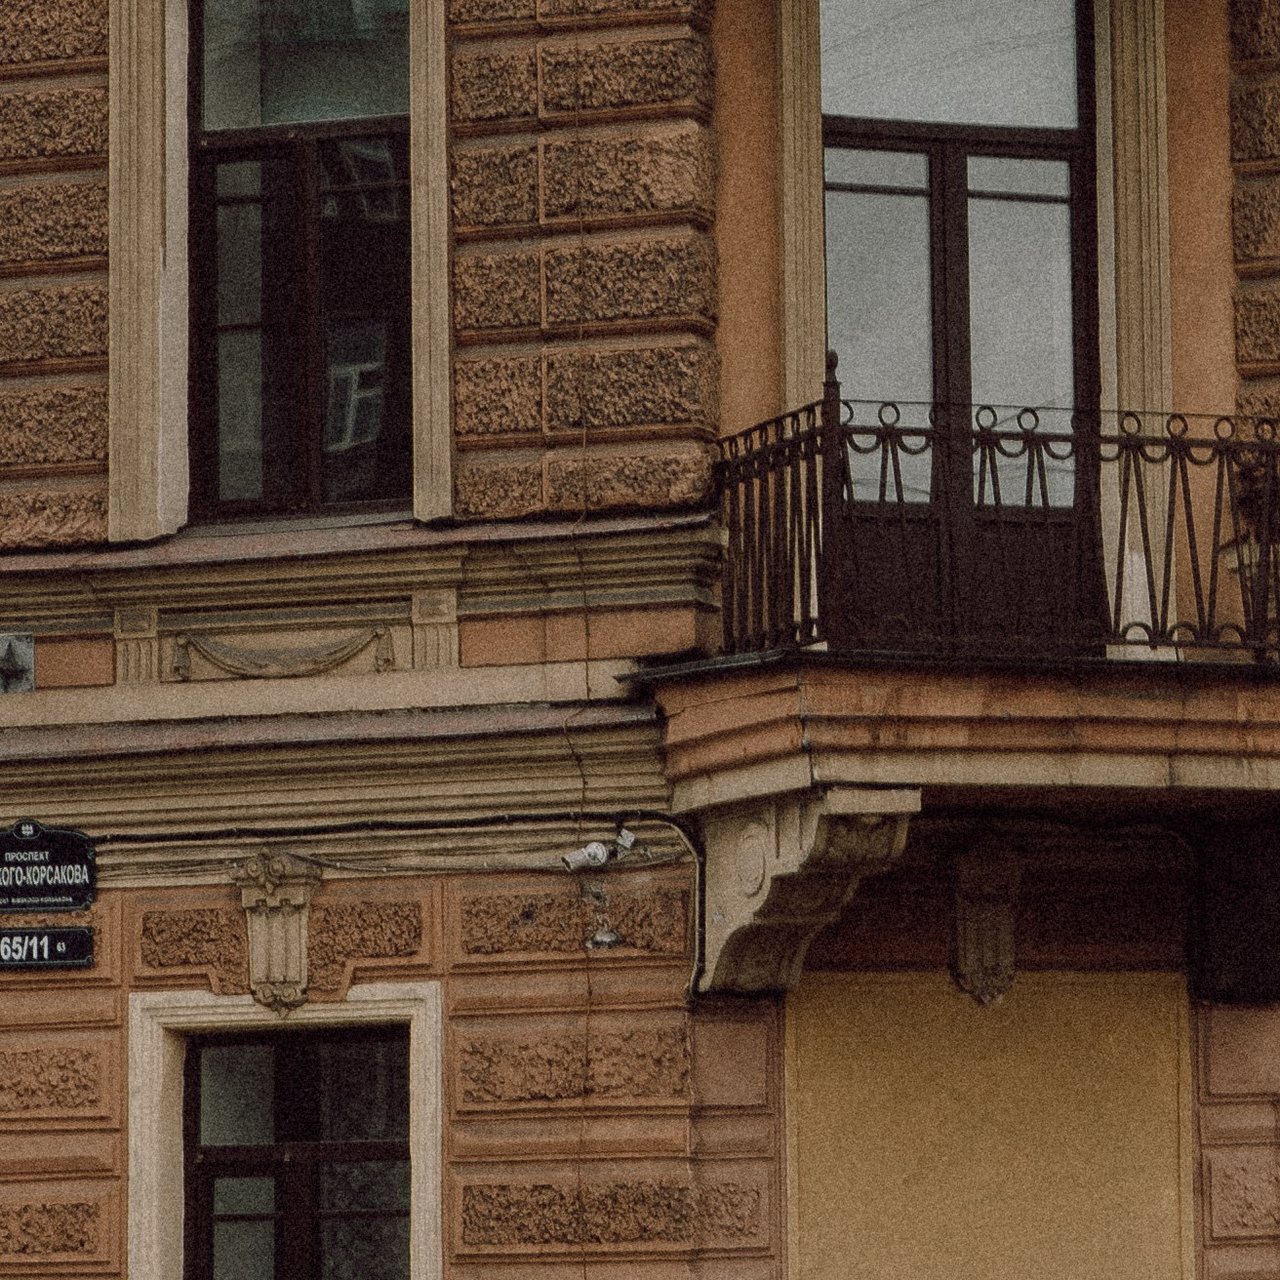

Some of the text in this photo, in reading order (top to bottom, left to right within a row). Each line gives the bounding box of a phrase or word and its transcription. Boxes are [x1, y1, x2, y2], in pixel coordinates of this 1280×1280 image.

[5, 851, 49, 861] ПРОСПЕКТ
[0, 864, 89, 885] ОГО-КОРСАКОВА
[0, 935, 49, 960] 65/11
